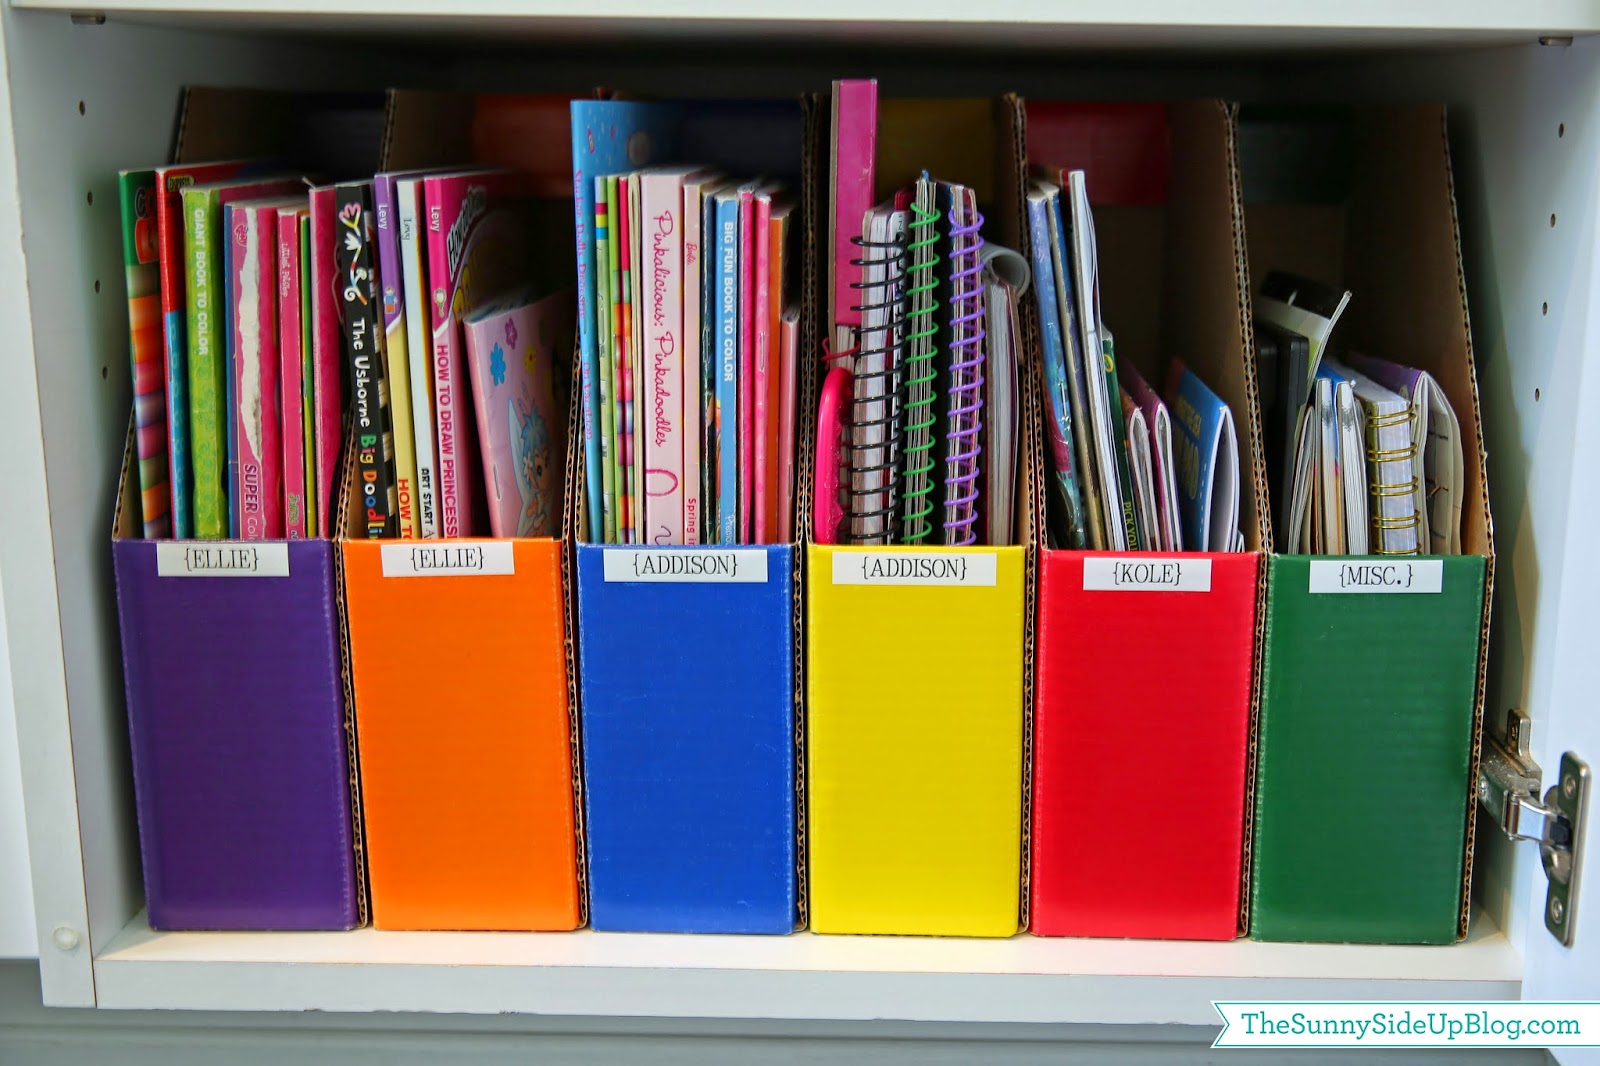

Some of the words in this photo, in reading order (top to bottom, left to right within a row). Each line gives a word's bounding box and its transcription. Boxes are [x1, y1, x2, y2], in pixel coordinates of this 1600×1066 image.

[194, 208, 206, 247] GIANT
[378, 204, 389, 230] Levy
[401, 218, 412, 241] Levy
[430, 206, 442, 232] Levy
[724, 222, 734, 244] BIG
[196, 251, 207, 288] BOOK
[653, 210, 674, 327] Pinkalicious:
[724, 248, 734, 274] FUN
[197, 291, 208, 309] TO
[723, 277, 734, 314] BOOK
[197, 312, 209, 356] COLOR
[352, 317, 366, 351] The
[724, 318, 734, 335] TO
[437, 344, 450, 382] HOW
[583, 362, 591, 380] On
[724, 338, 734, 382] COLOR
[354, 355, 371, 428] Usborne
[438, 385, 451, 407] TO
[654, 331, 675, 448] Pinkadoodles
[583, 382, 593, 441] Vacation
[440, 411, 454, 456] DRAW
[360, 434, 377, 464] Big
[244, 463, 259, 514] SUPER
[421, 468, 431, 490] ART
[398, 478, 412, 521] HOW
[423, 492, 434, 526] START
[687, 498, 697, 534] Spring
[1122, 501, 1134, 528] PICK
[424, 529, 436, 539] A
[184, 547, 260, 572] {ELLIE}
[410, 546, 484, 571] {ELLIE}
[632, 554, 739, 577] {ADDISON}
[861, 556, 968, 581] {ADDISON}
[1112, 562, 1183, 586] {KOLE}
[1339, 564, 1414, 588] {MISC.}
